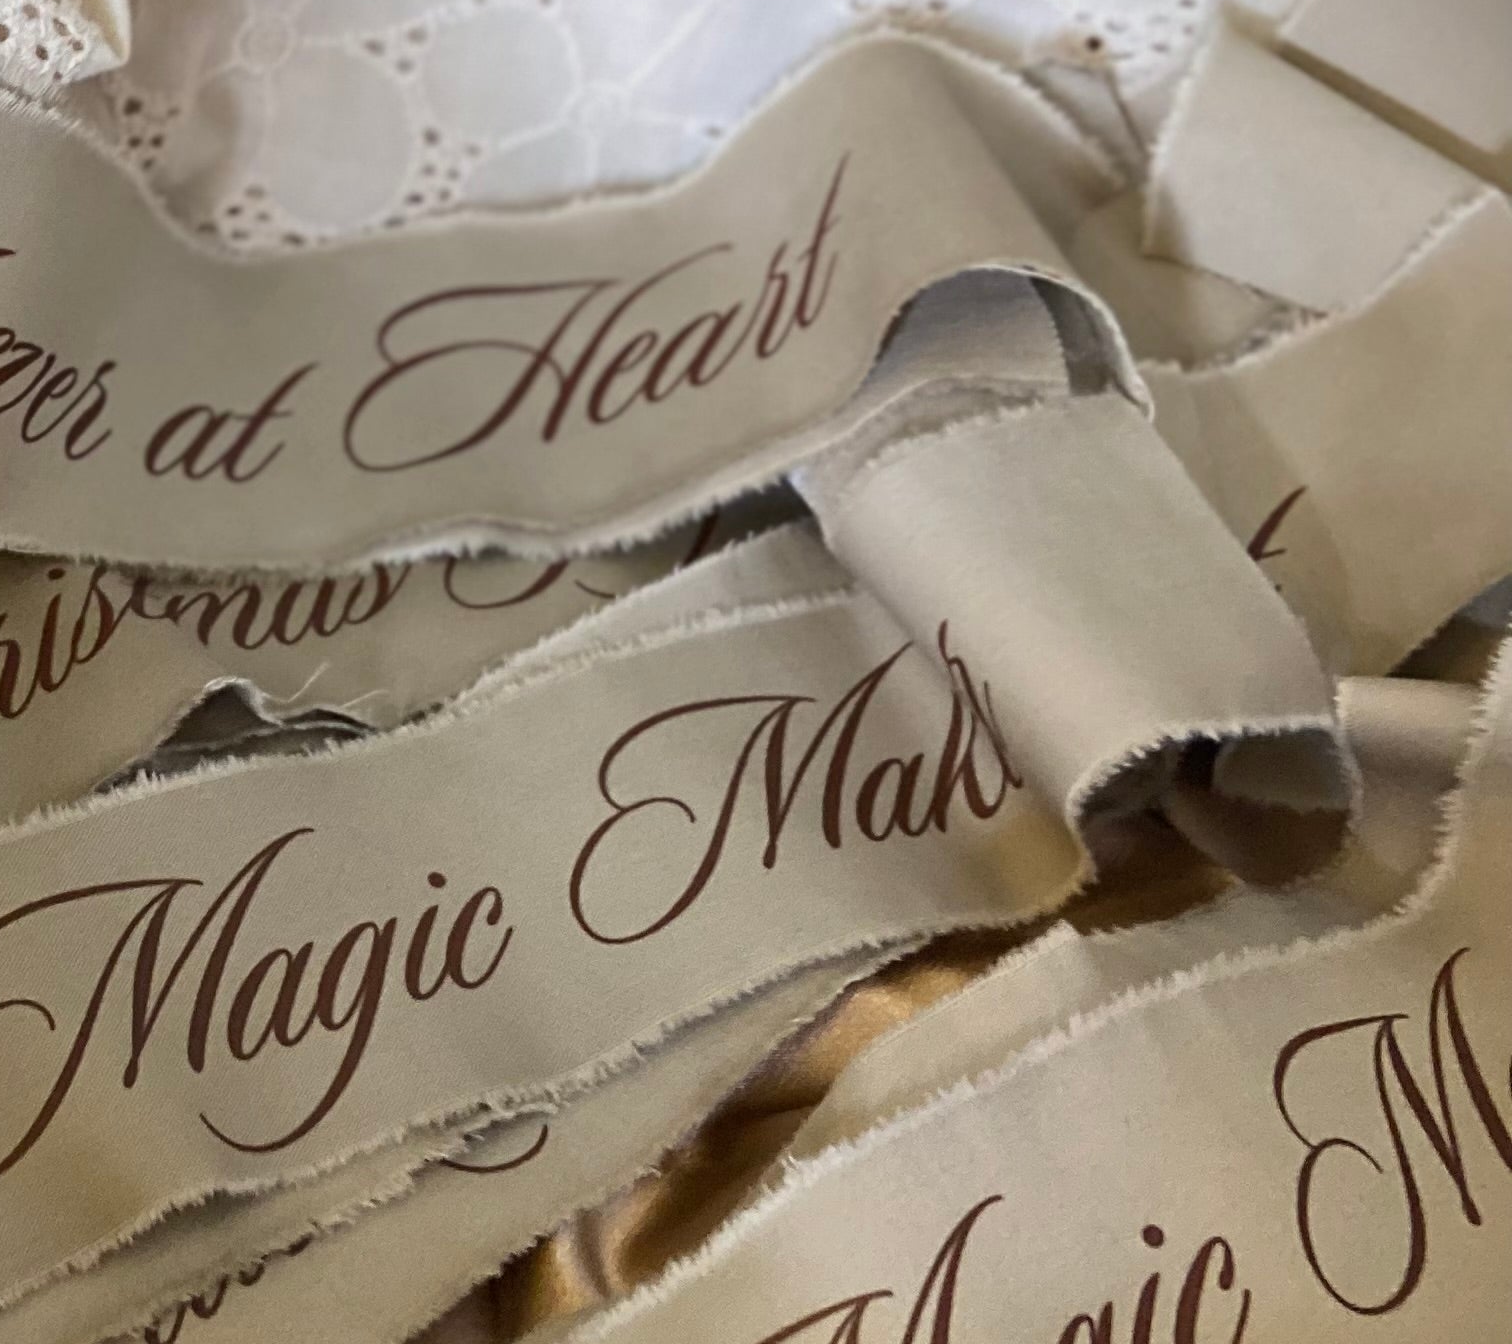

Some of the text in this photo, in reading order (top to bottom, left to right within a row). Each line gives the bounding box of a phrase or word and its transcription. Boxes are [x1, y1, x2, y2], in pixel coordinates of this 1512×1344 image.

[144, 361, 321, 483] at
[343, 150, 852, 473] Heart
[1273, 946, 1512, 1316] M
